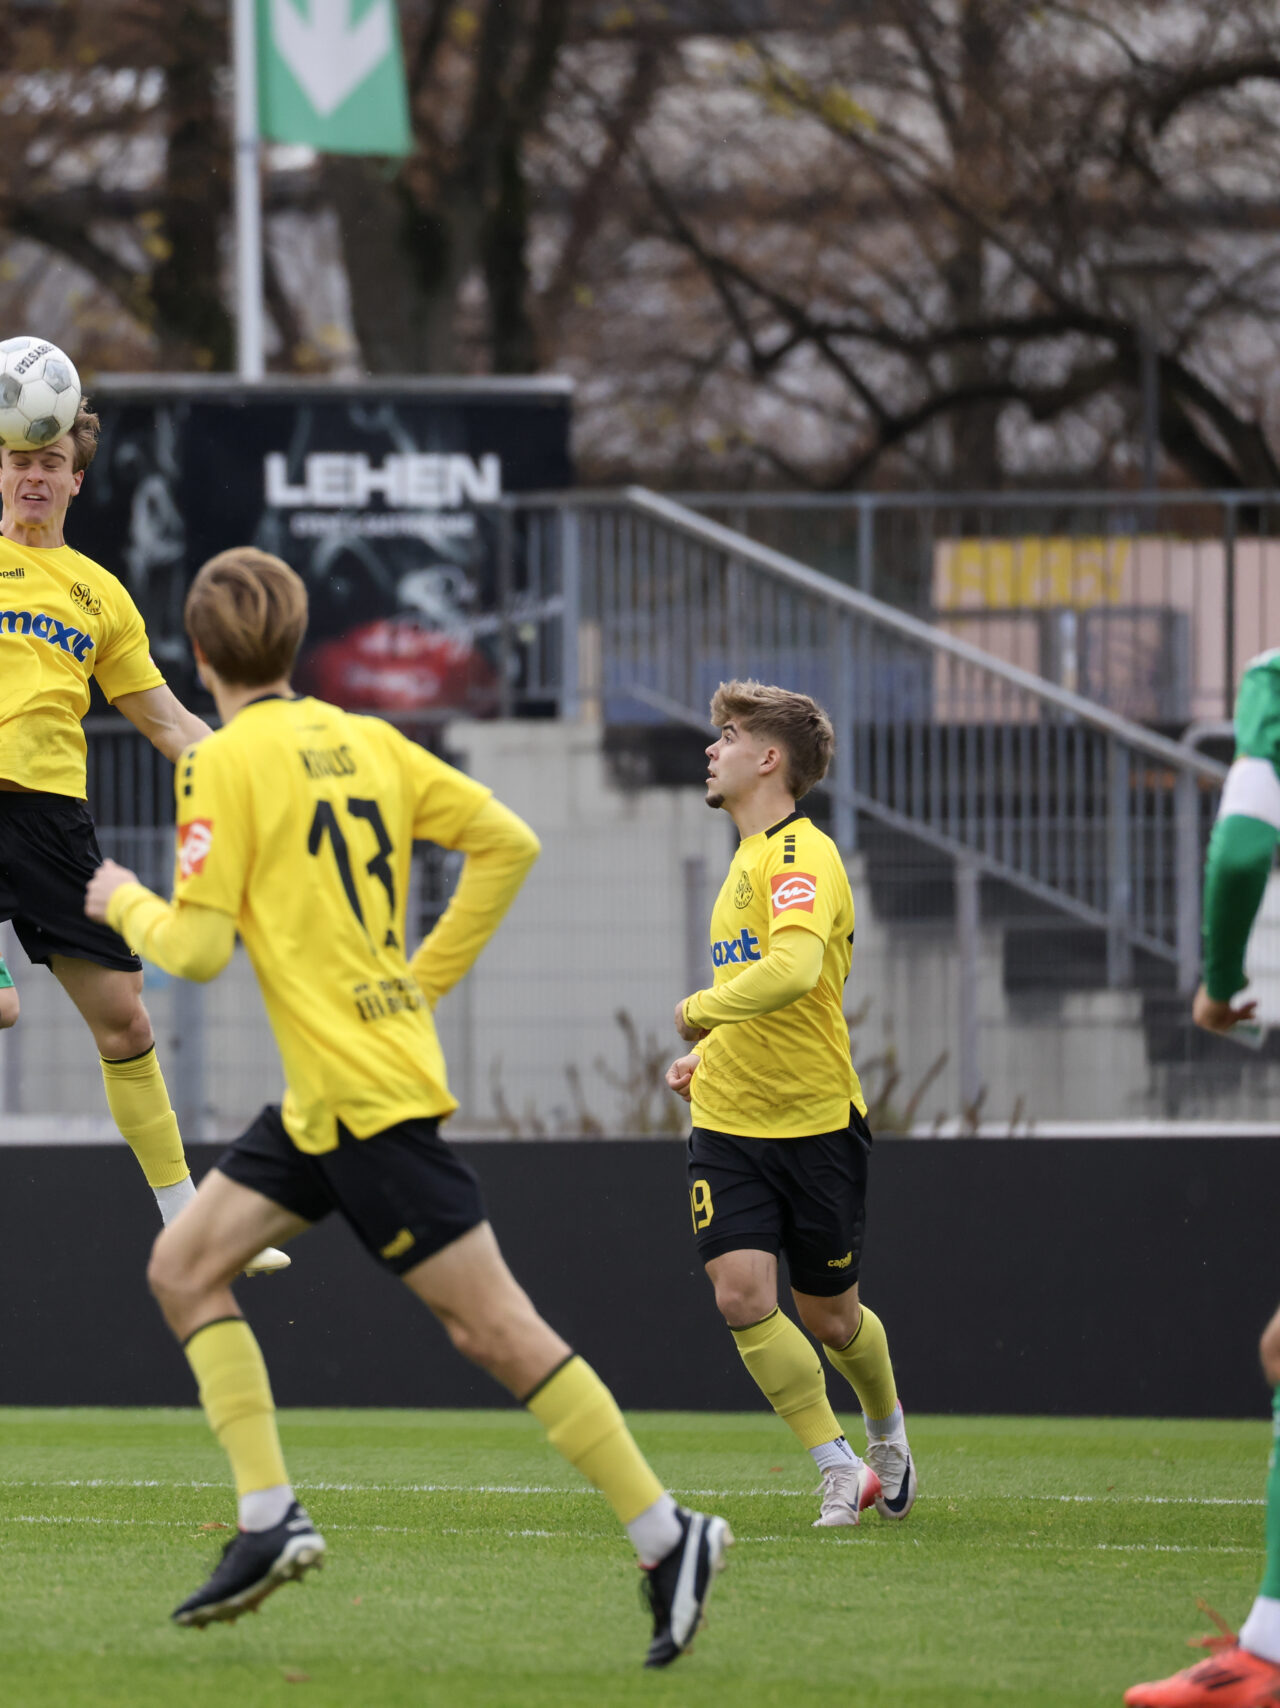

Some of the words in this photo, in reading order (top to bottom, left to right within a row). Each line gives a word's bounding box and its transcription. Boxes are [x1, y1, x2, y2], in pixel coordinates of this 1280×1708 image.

[265, 452, 502, 508] LEHEN
[308, 796, 400, 955] 13
[711, 928, 762, 967] axit
